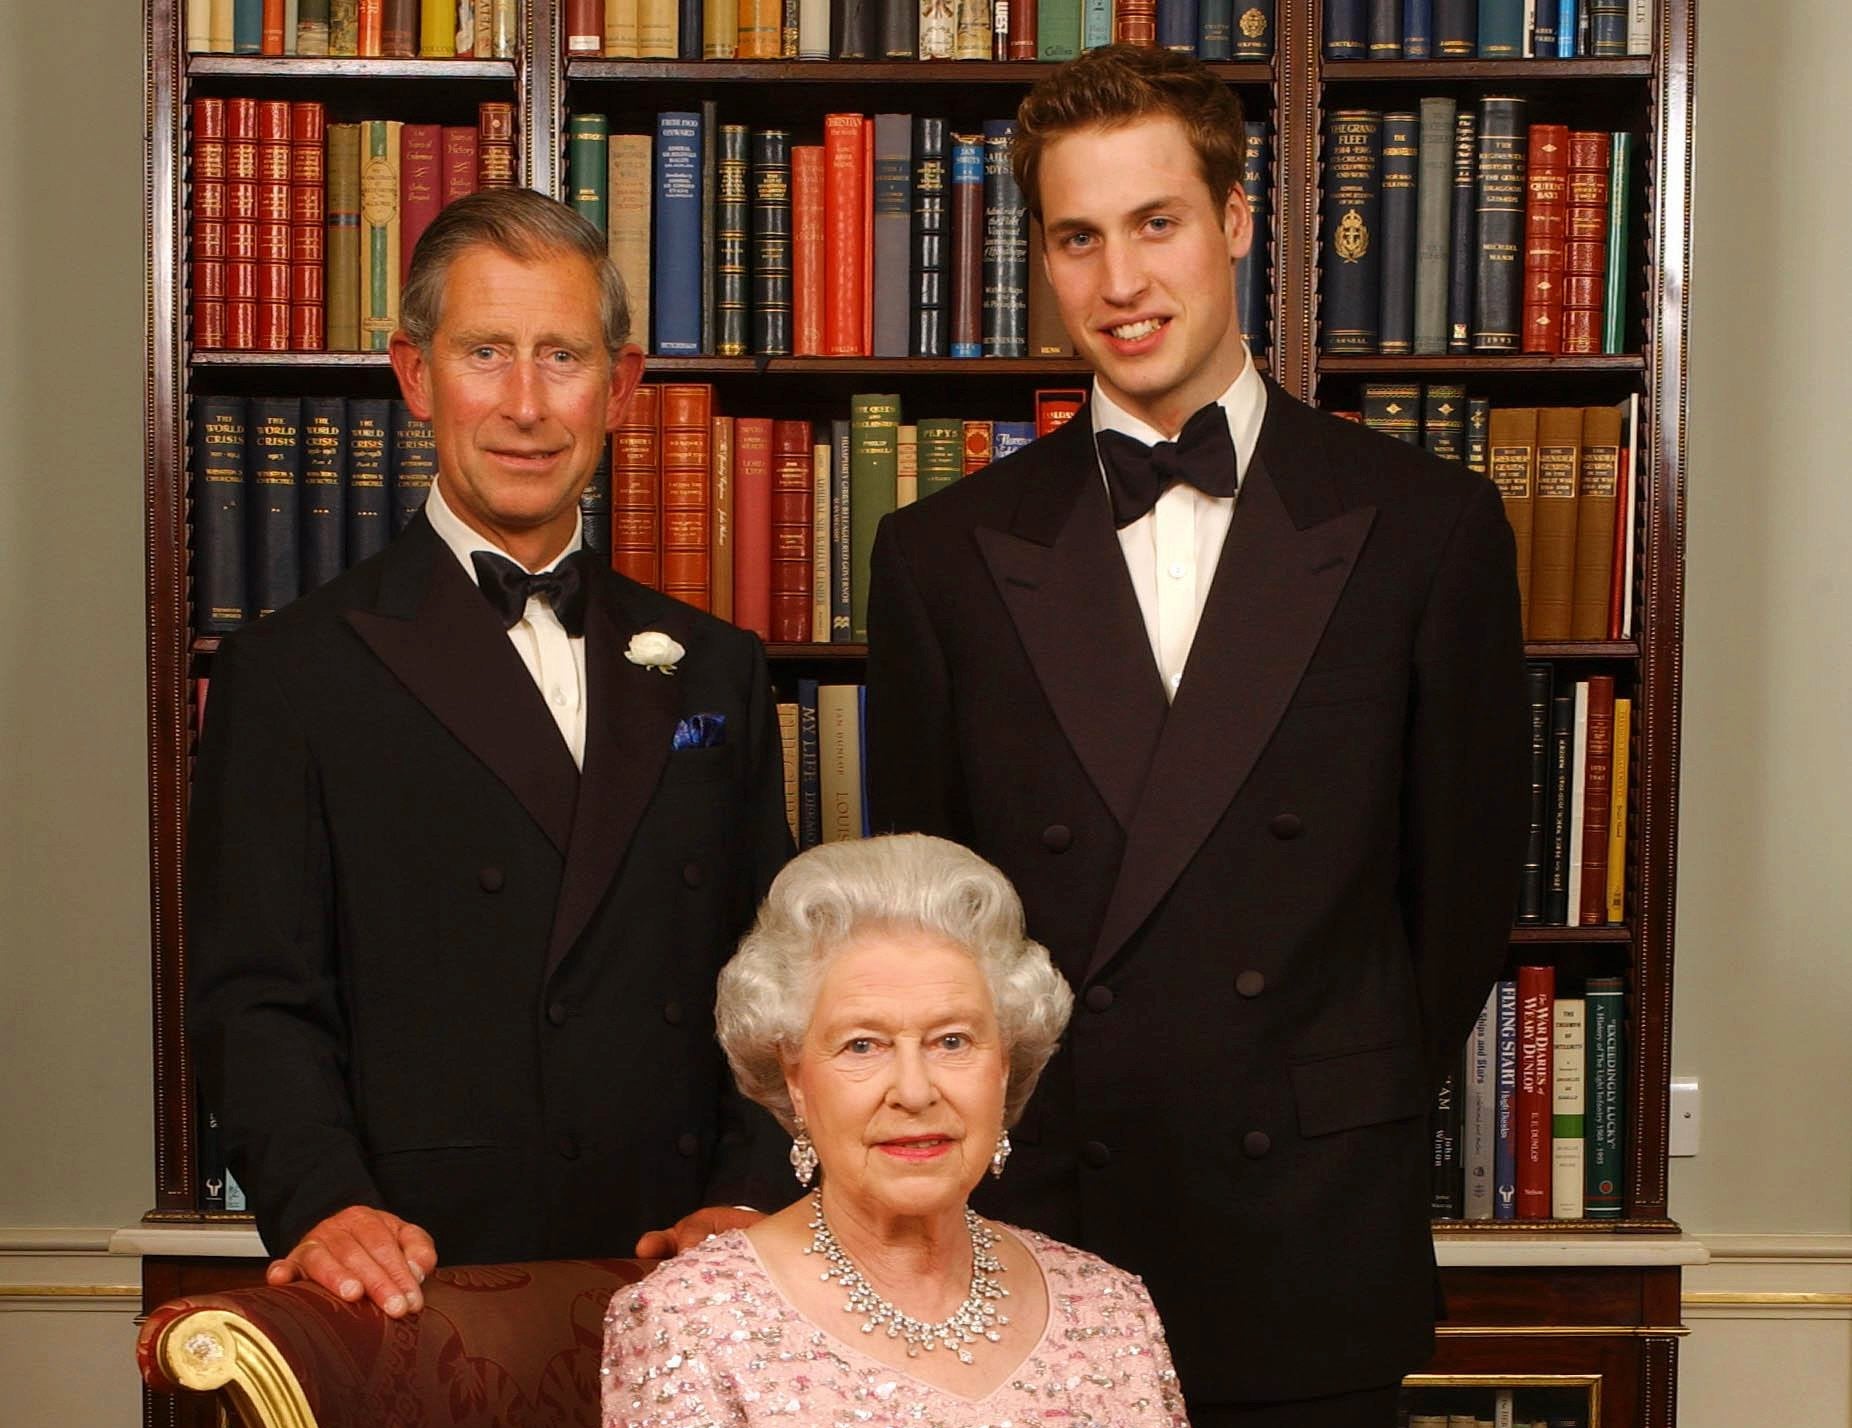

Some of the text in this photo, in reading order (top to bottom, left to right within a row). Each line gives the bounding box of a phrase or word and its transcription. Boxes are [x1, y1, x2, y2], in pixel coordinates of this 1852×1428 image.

[1338, 134, 1368, 145] FLEET
[205, 424, 246, 433] WORLD
[256, 427, 297, 436] WORLD
[305, 427, 340, 435] WORLD
[352, 429, 385, 438] WORLD
[205, 435, 246, 444] CRISIS
[256, 437, 297, 446] CRISIS
[305, 437, 339, 446] CRISIS
[351, 440, 385, 449] CRISIS
[841, 561, 850, 604] GOVERNOR
[835, 791, 850, 843] LOUIS
[1501, 986, 1516, 1037] FLYING
[1536, 1007, 1549, 1035] WAR
[1594, 1012, 1605, 1041] History
[1522, 997, 1537, 1094] WEARY DUNLOP
[1596, 1042, 1605, 1052] of
[1501, 1040, 1516, 1088] START
[1536, 1036, 1549, 1086] DIARIES
[1443, 1136, 1454, 1160] John
